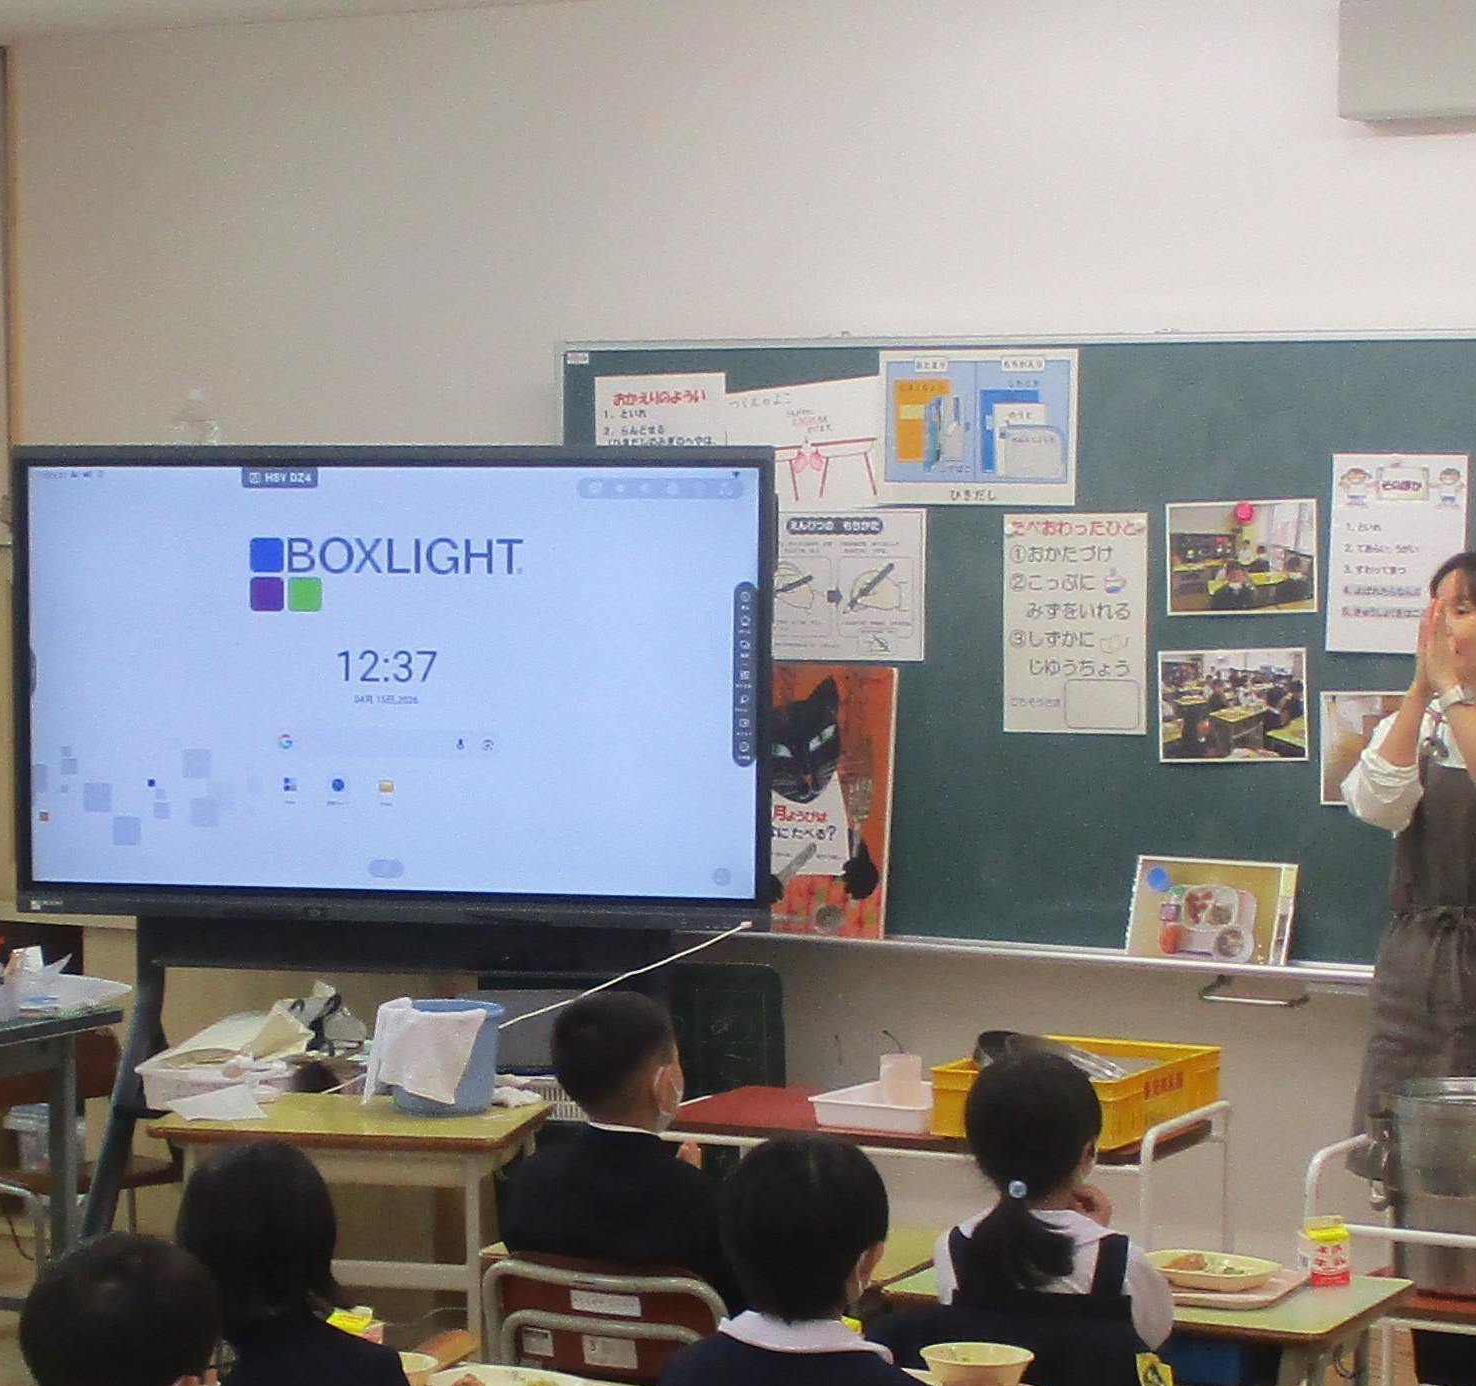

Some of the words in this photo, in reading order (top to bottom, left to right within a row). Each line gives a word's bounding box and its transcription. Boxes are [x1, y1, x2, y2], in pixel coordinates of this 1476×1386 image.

[950, 490, 997, 502] ひきだし
[287, 537, 524, 575] BOXLIGHT
[1026, 602, 1132, 621] みずをいれる
[337, 650, 437, 682] 12:37
